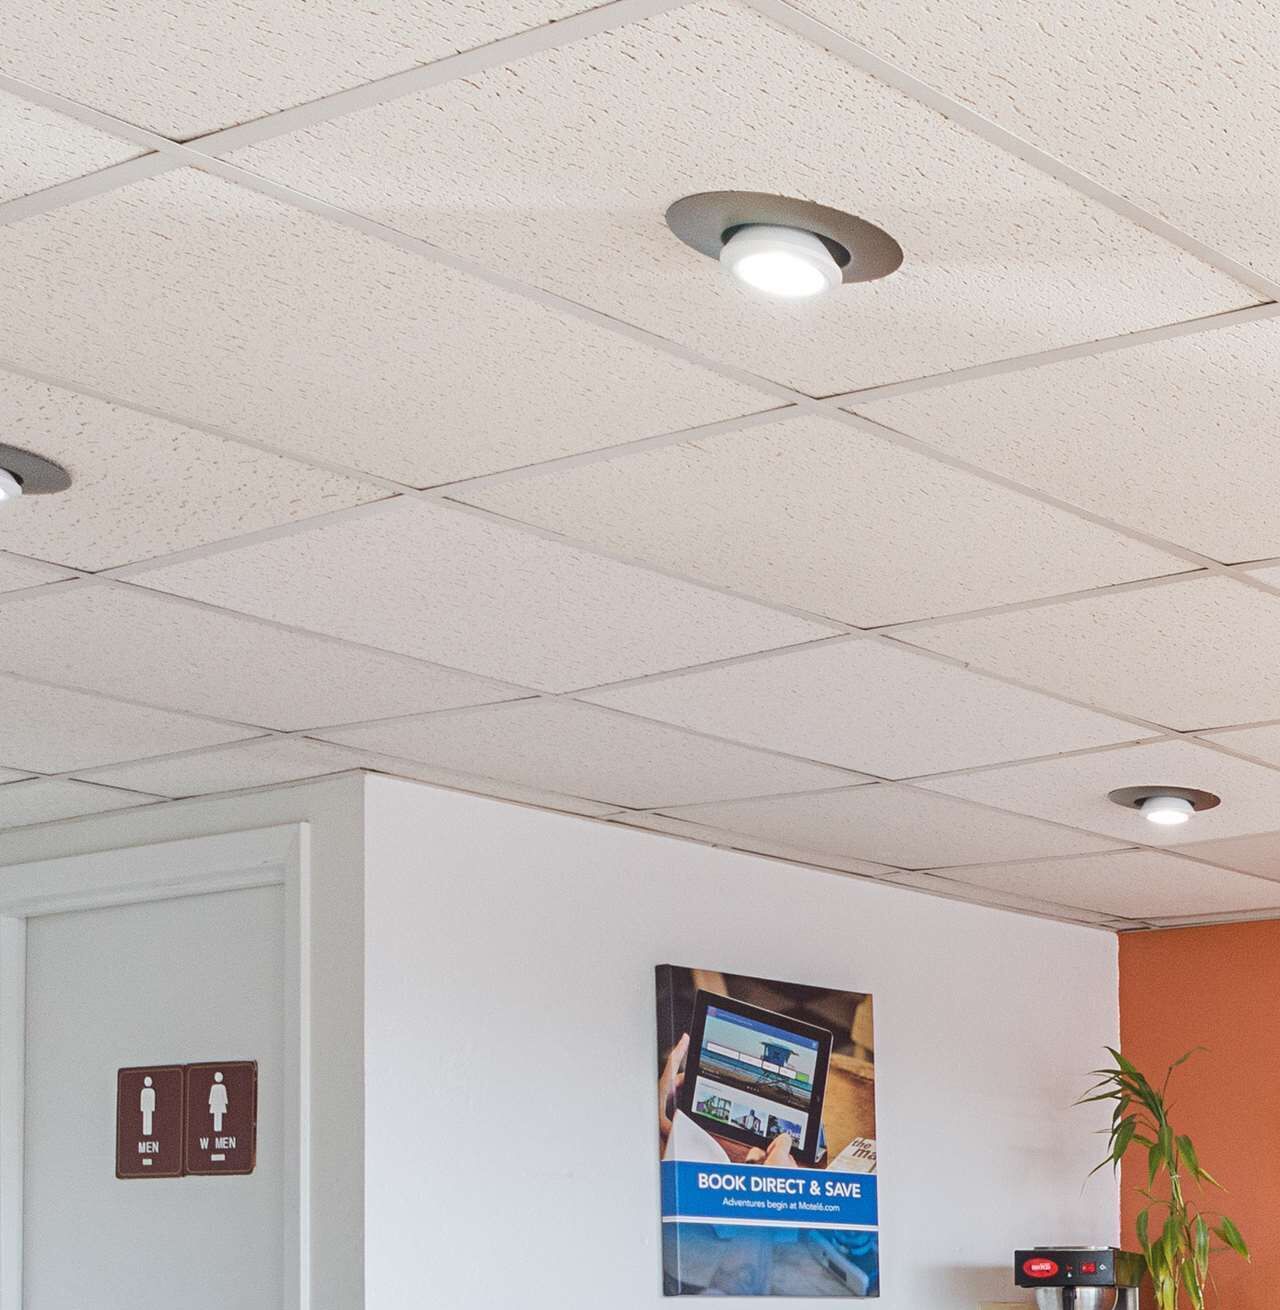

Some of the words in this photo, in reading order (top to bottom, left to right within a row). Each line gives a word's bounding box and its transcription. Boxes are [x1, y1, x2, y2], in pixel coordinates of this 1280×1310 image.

[138, 1141, 159, 1154] MEN
[852, 1138, 872, 1149] the
[698, 1173, 746, 1191] BOOK
[751, 1177, 806, 1194] DIRECT
[810, 1182, 821, 1195] &
[825, 1182, 861, 1198] SAVE
[723, 1197, 765, 1208] Adventures
[766, 1200, 788, 1211] begin
[789, 1201, 797, 1209] at
[798, 1201, 840, 1212] Motel6.com
